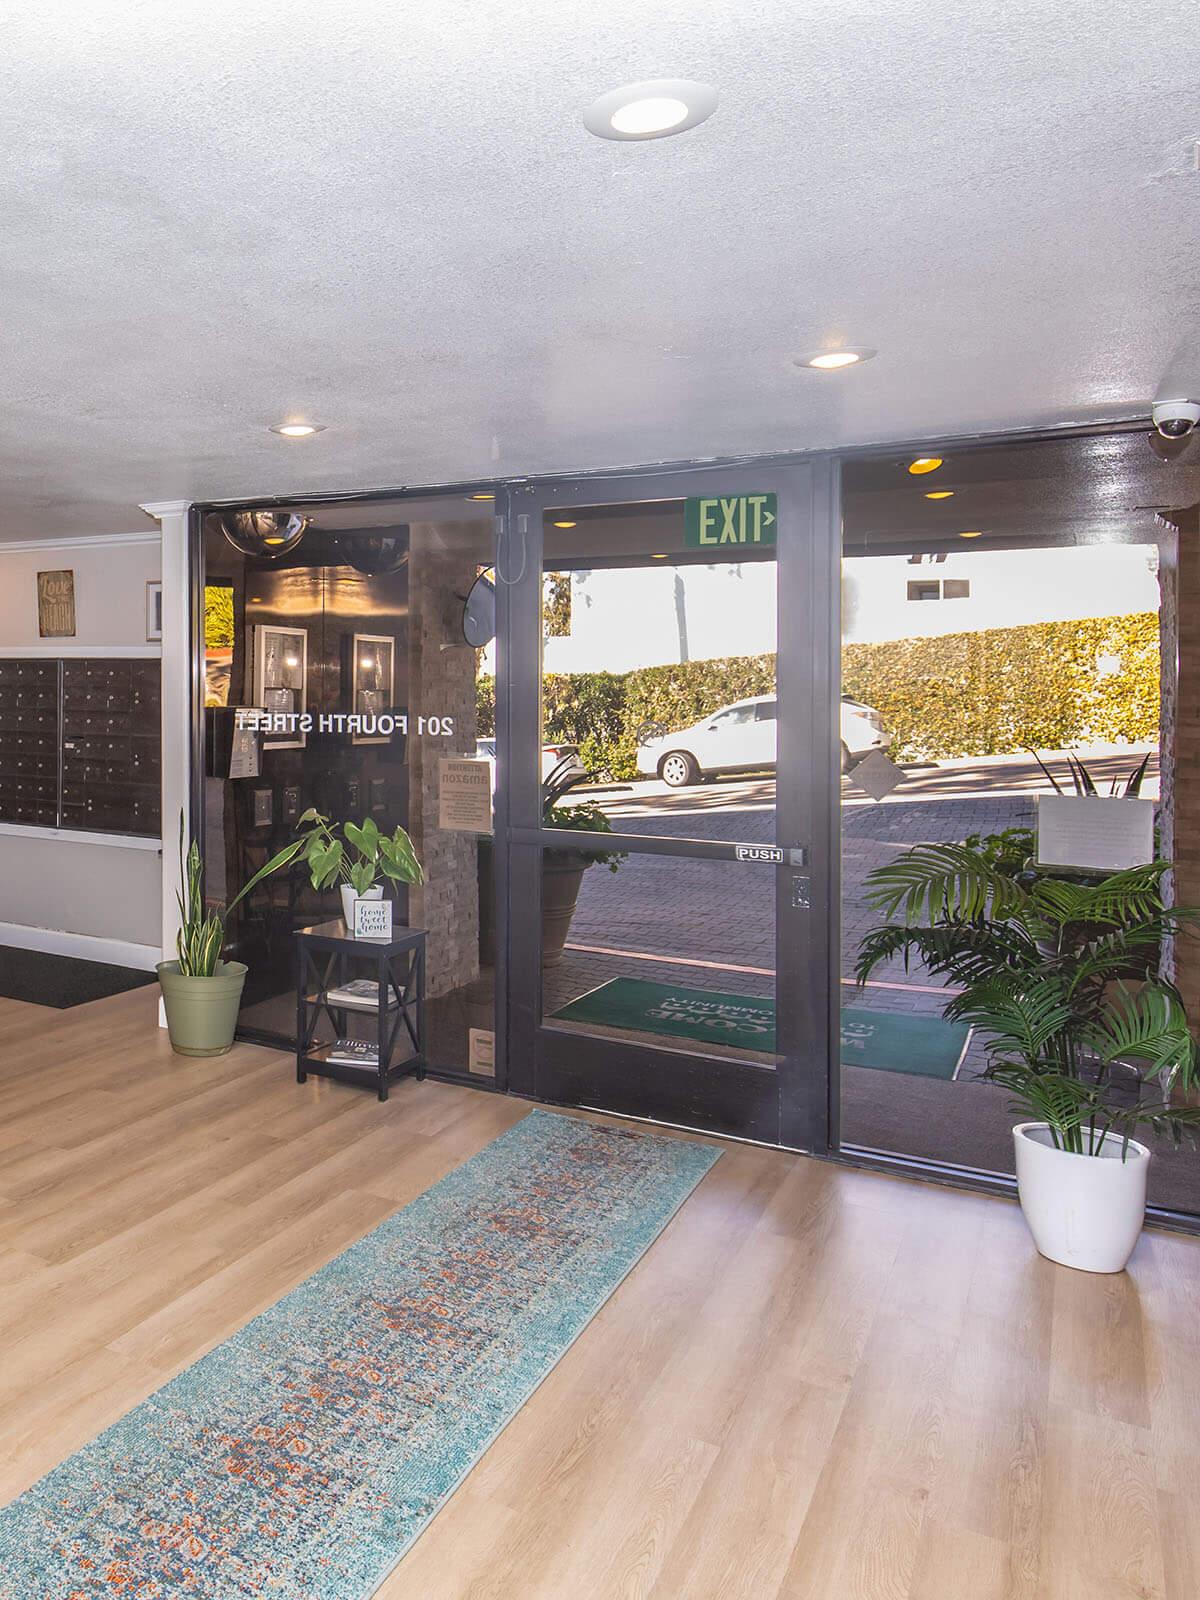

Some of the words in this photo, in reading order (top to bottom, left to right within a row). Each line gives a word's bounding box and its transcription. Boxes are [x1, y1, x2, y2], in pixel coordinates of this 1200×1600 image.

[699, 495, 768, 545] EXIT
[739, 848, 781, 860] PUSH
[665, 997, 775, 1016] OMMUNITY
